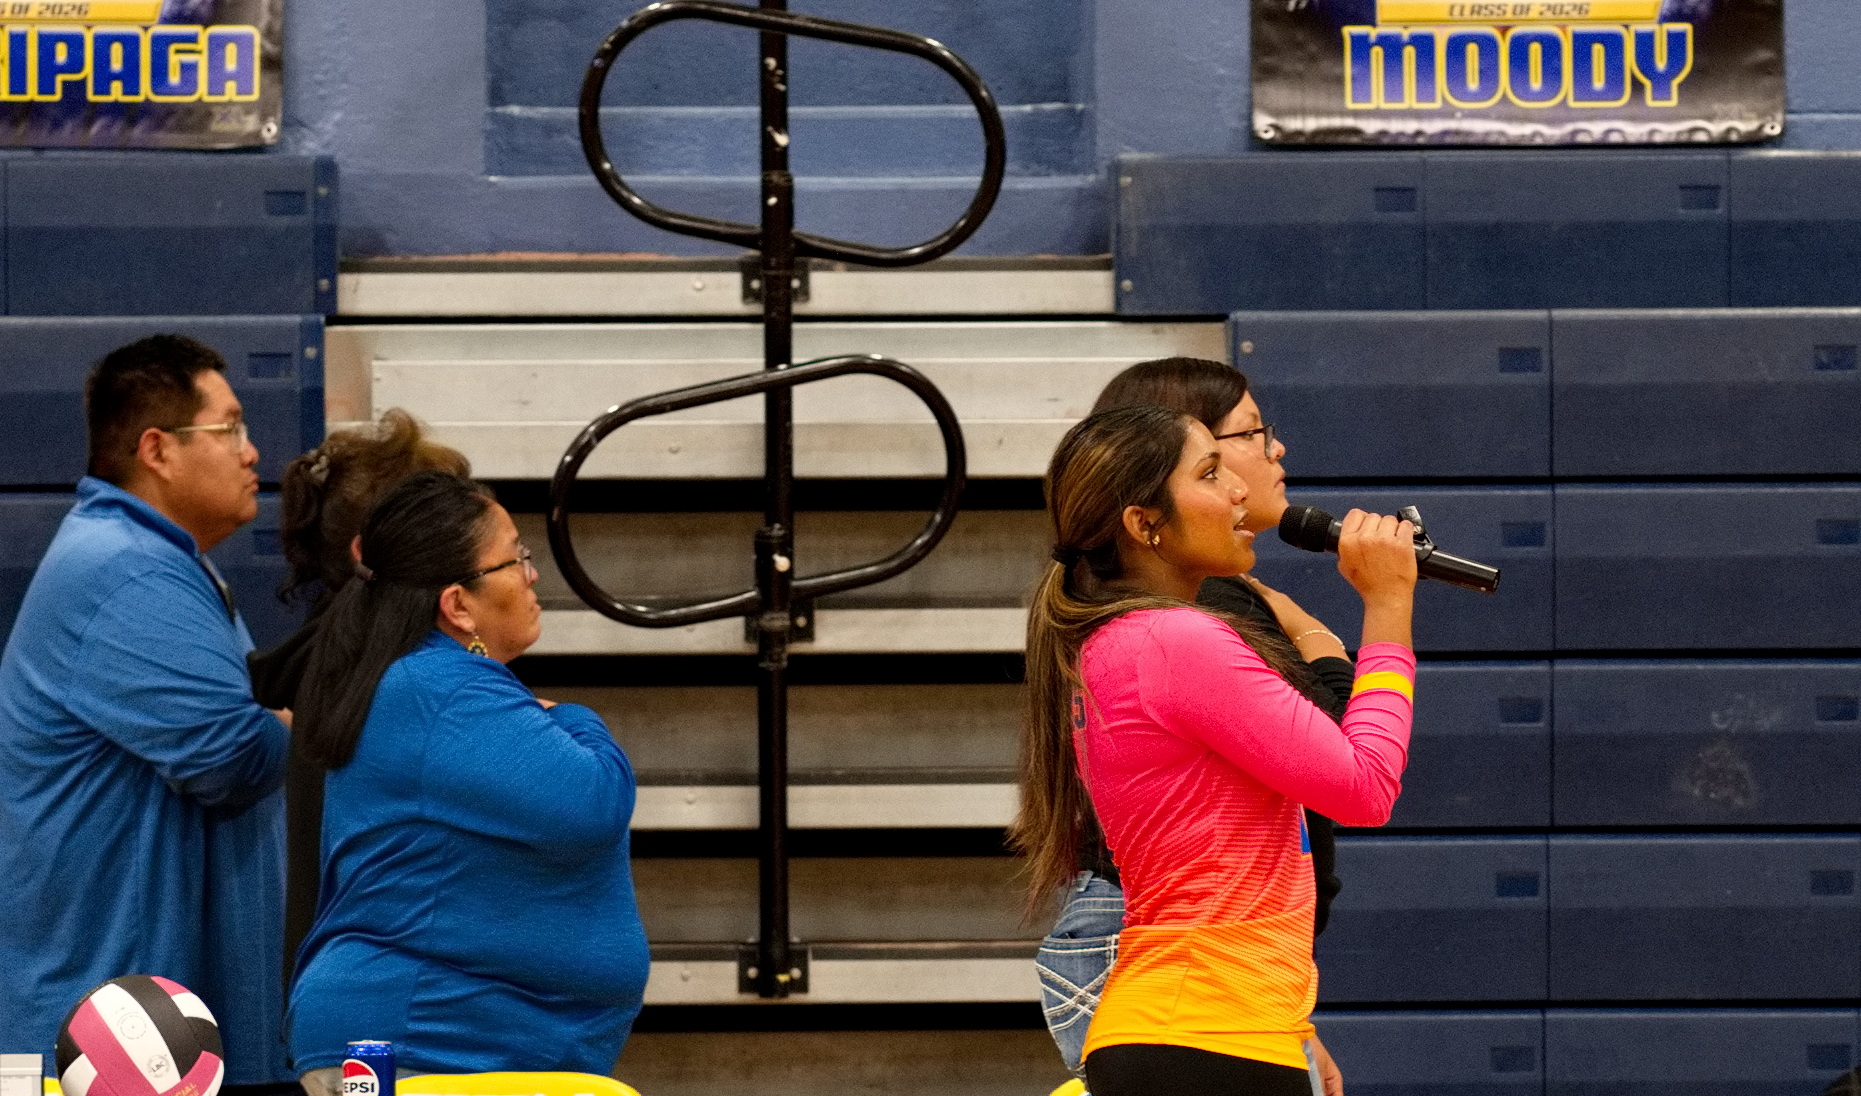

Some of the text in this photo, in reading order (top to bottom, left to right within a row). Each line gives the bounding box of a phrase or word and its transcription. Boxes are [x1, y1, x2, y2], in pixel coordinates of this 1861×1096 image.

[1448, 3, 1591, 16] CLASS OF 2026
[0, 24, 261, 103] IPAGA
[1342, 23, 1694, 109] MOODY
